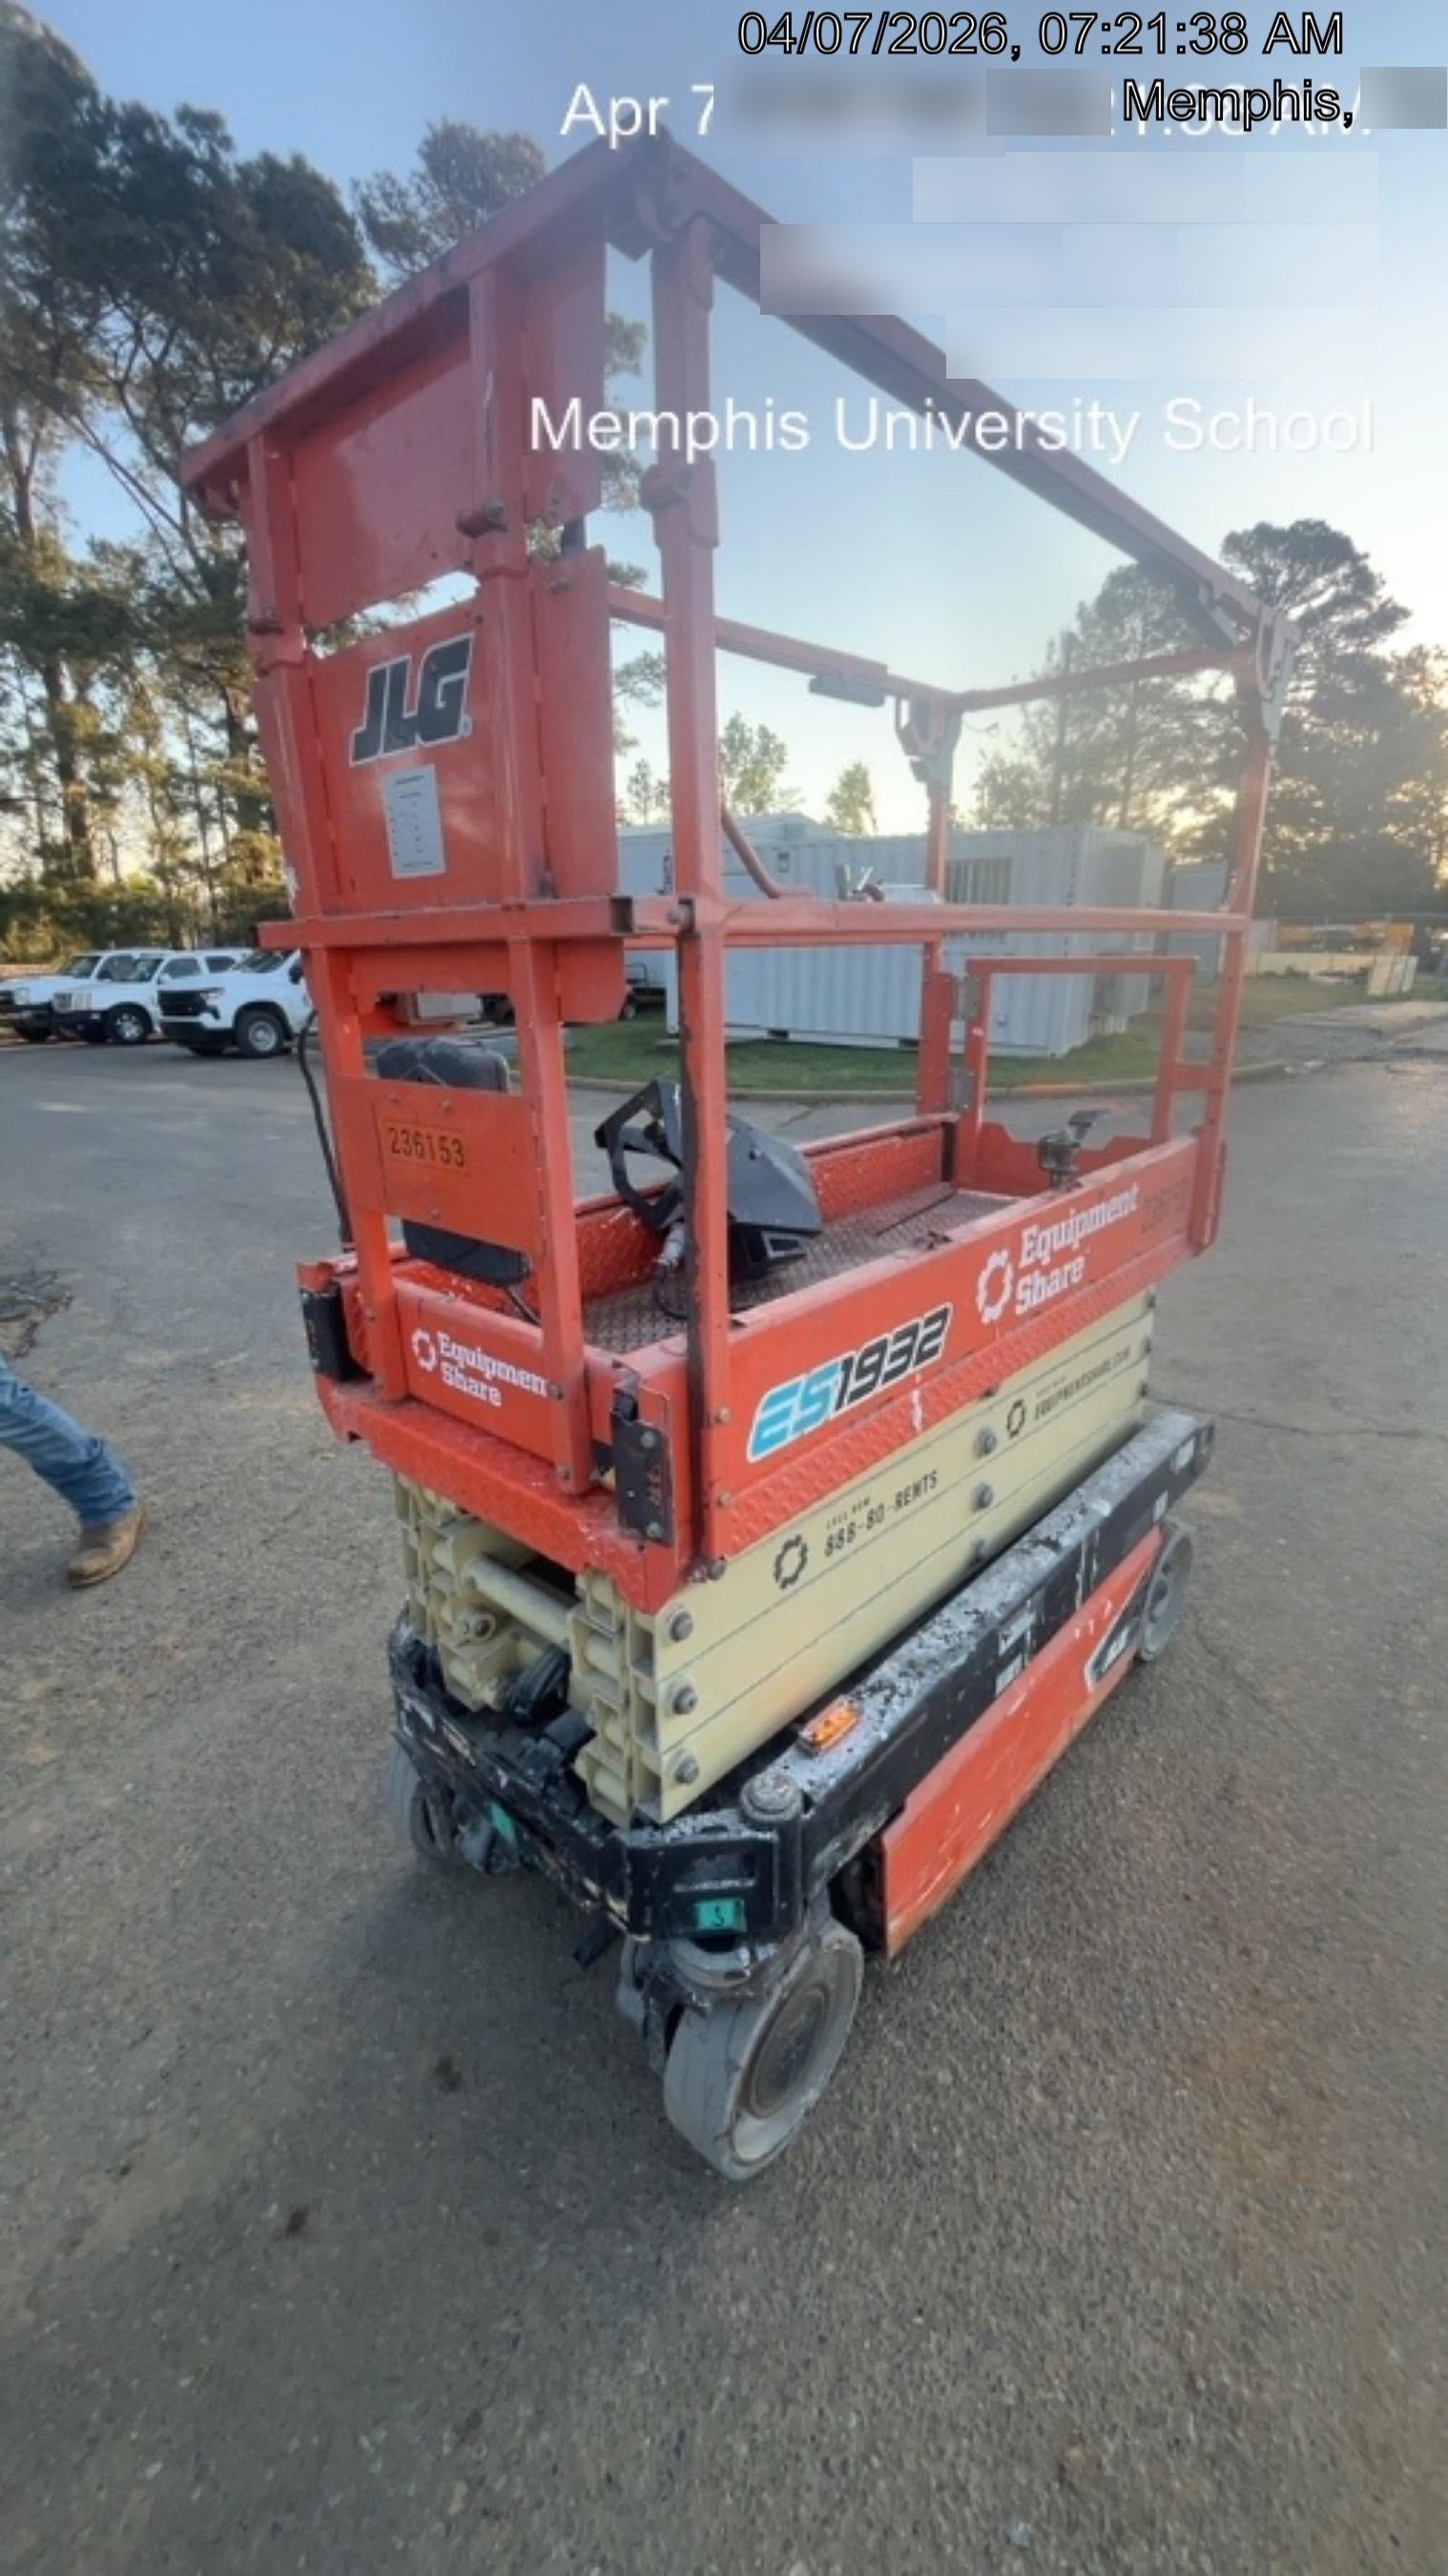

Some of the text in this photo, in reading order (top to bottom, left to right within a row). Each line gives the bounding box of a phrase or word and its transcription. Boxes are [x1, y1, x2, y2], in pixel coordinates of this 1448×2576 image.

[350, 633, 474, 766] JLG
[388, 1127, 465, 1169] 236153
[1018, 1182, 1139, 1269] Equipment
[1015, 1256, 1086, 1316] Share
[437, 1330, 548, 1398] Equipmen
[440, 1361, 502, 1406] Share
[747, 1301, 953, 1463] ES1932
